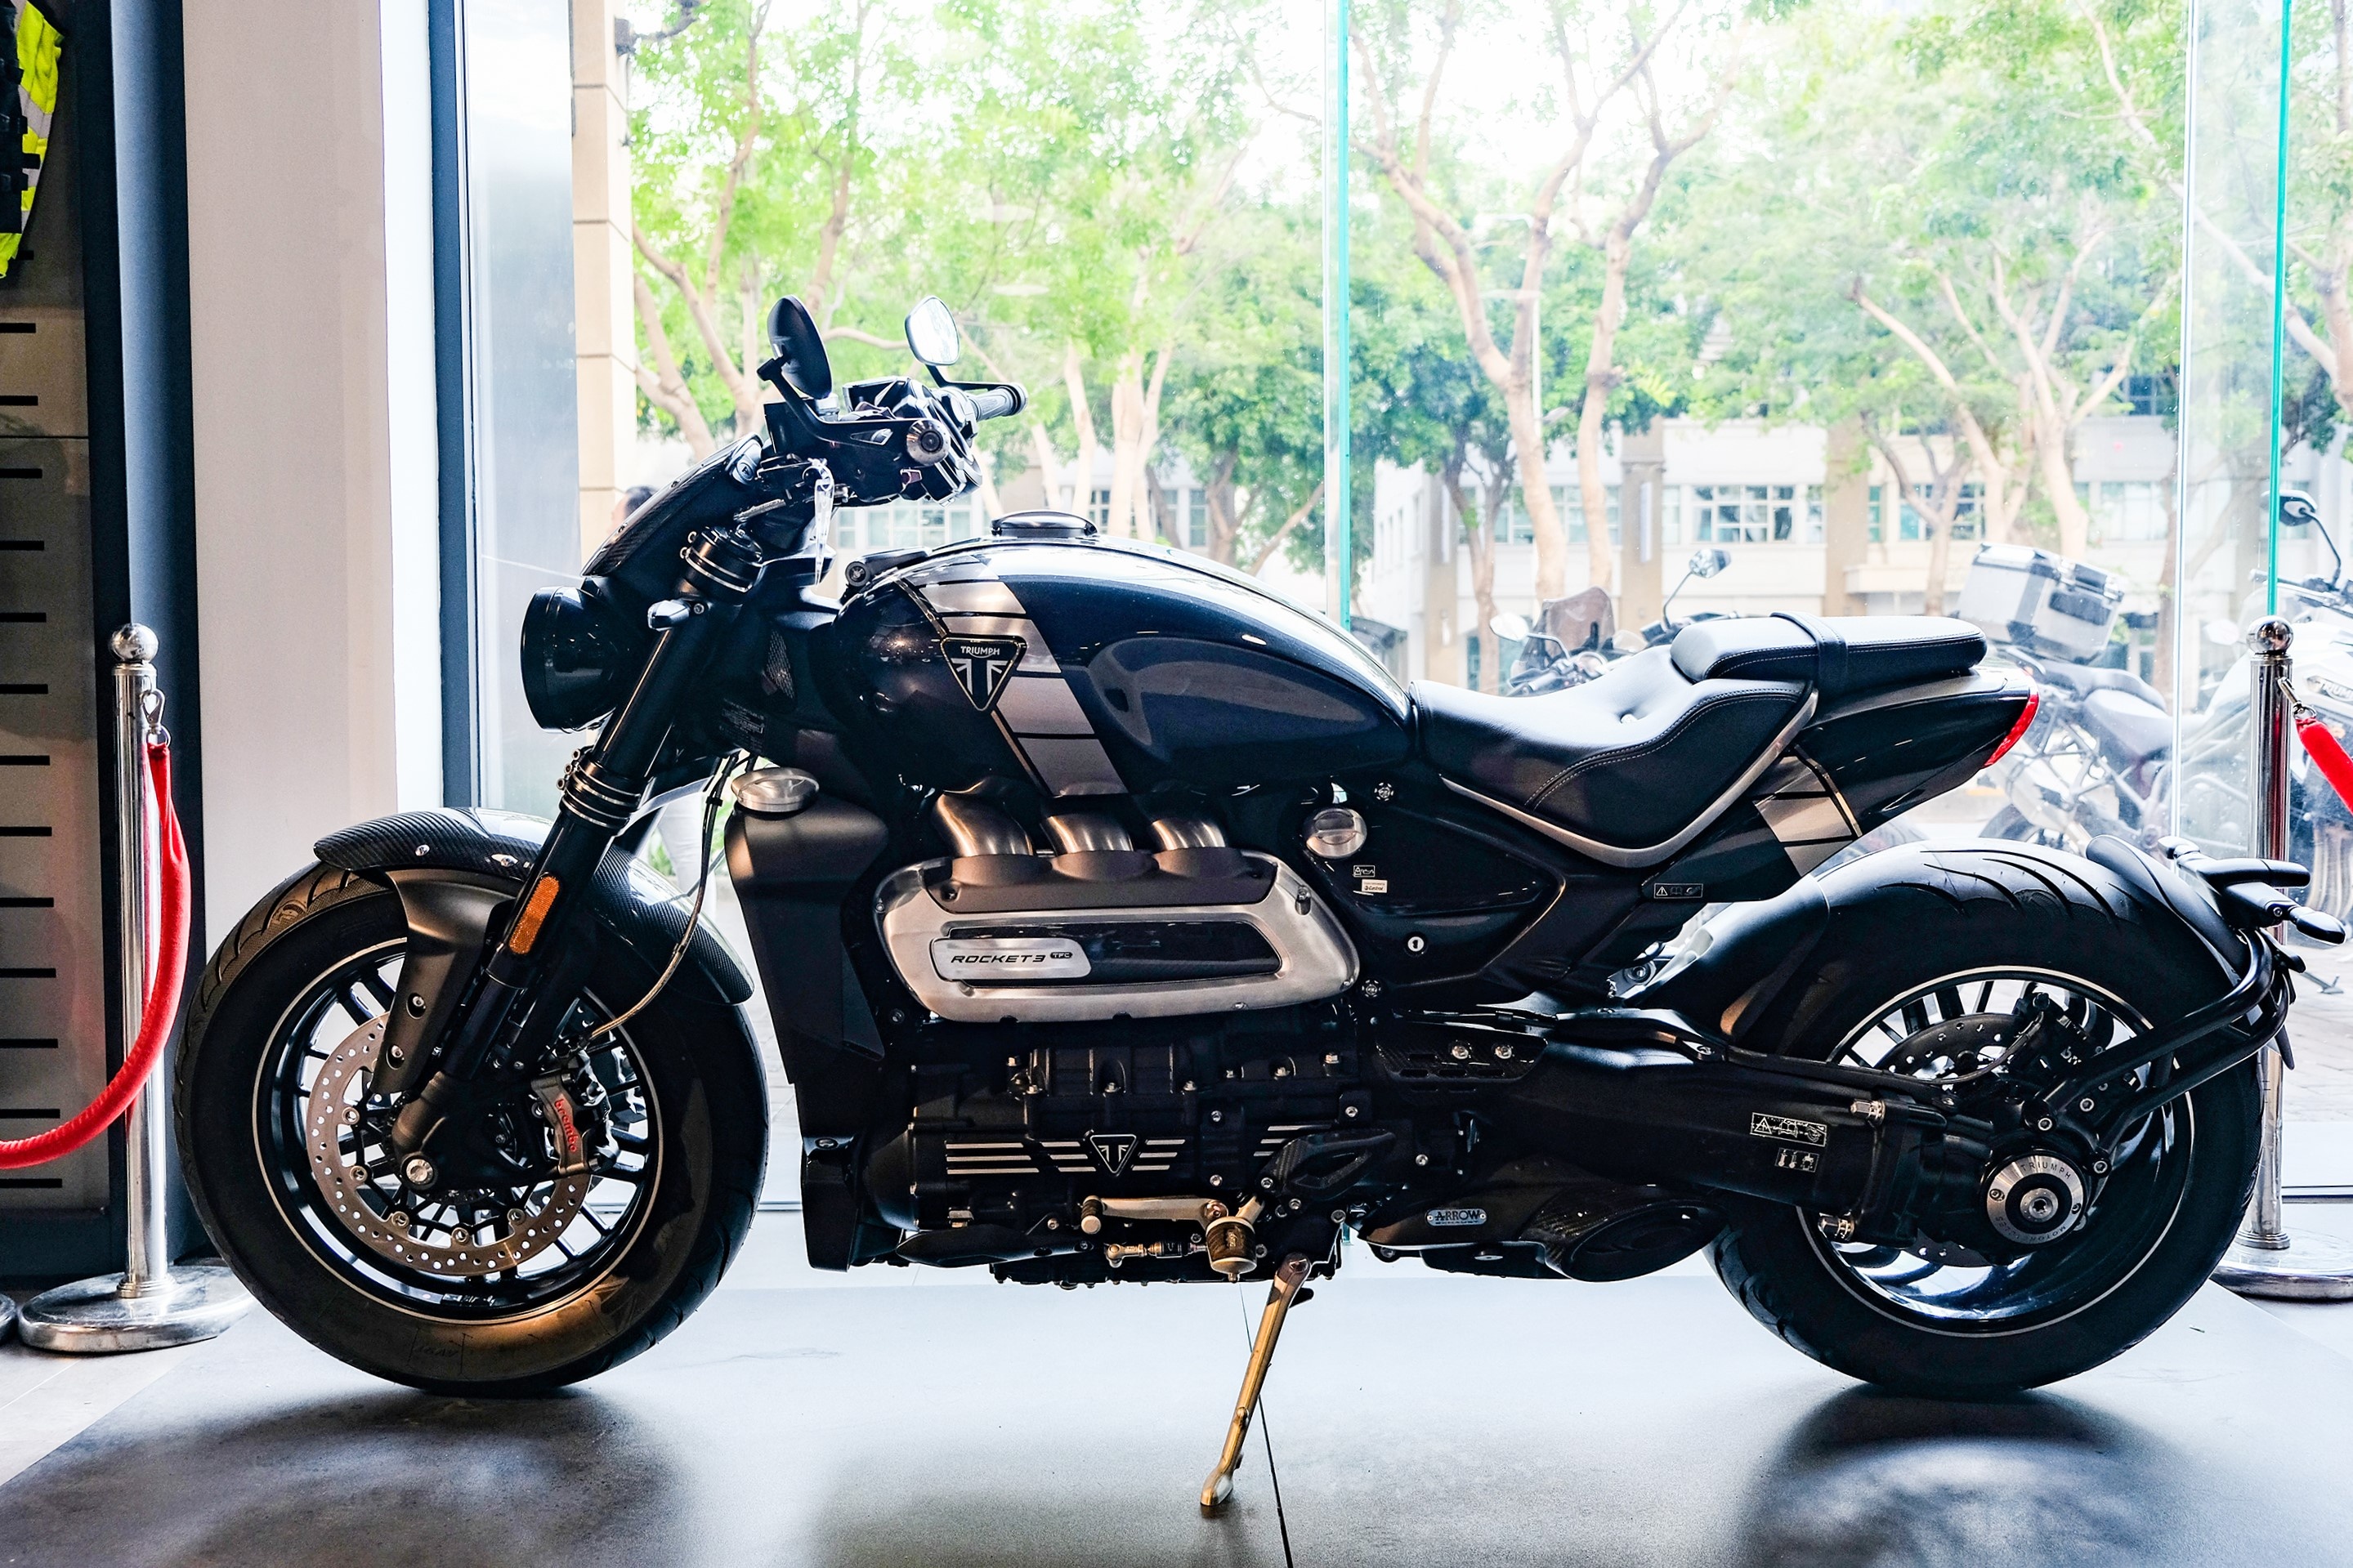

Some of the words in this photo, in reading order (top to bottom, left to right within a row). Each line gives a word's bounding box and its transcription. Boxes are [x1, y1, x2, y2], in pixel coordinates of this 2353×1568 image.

[960, 646, 1000, 657] TRIUMPH
[554, 1098, 578, 1152] brembo
[2020, 1161, 2071, 1179] TRIUMPH
[1434, 1210, 1480, 1221] ARROW
